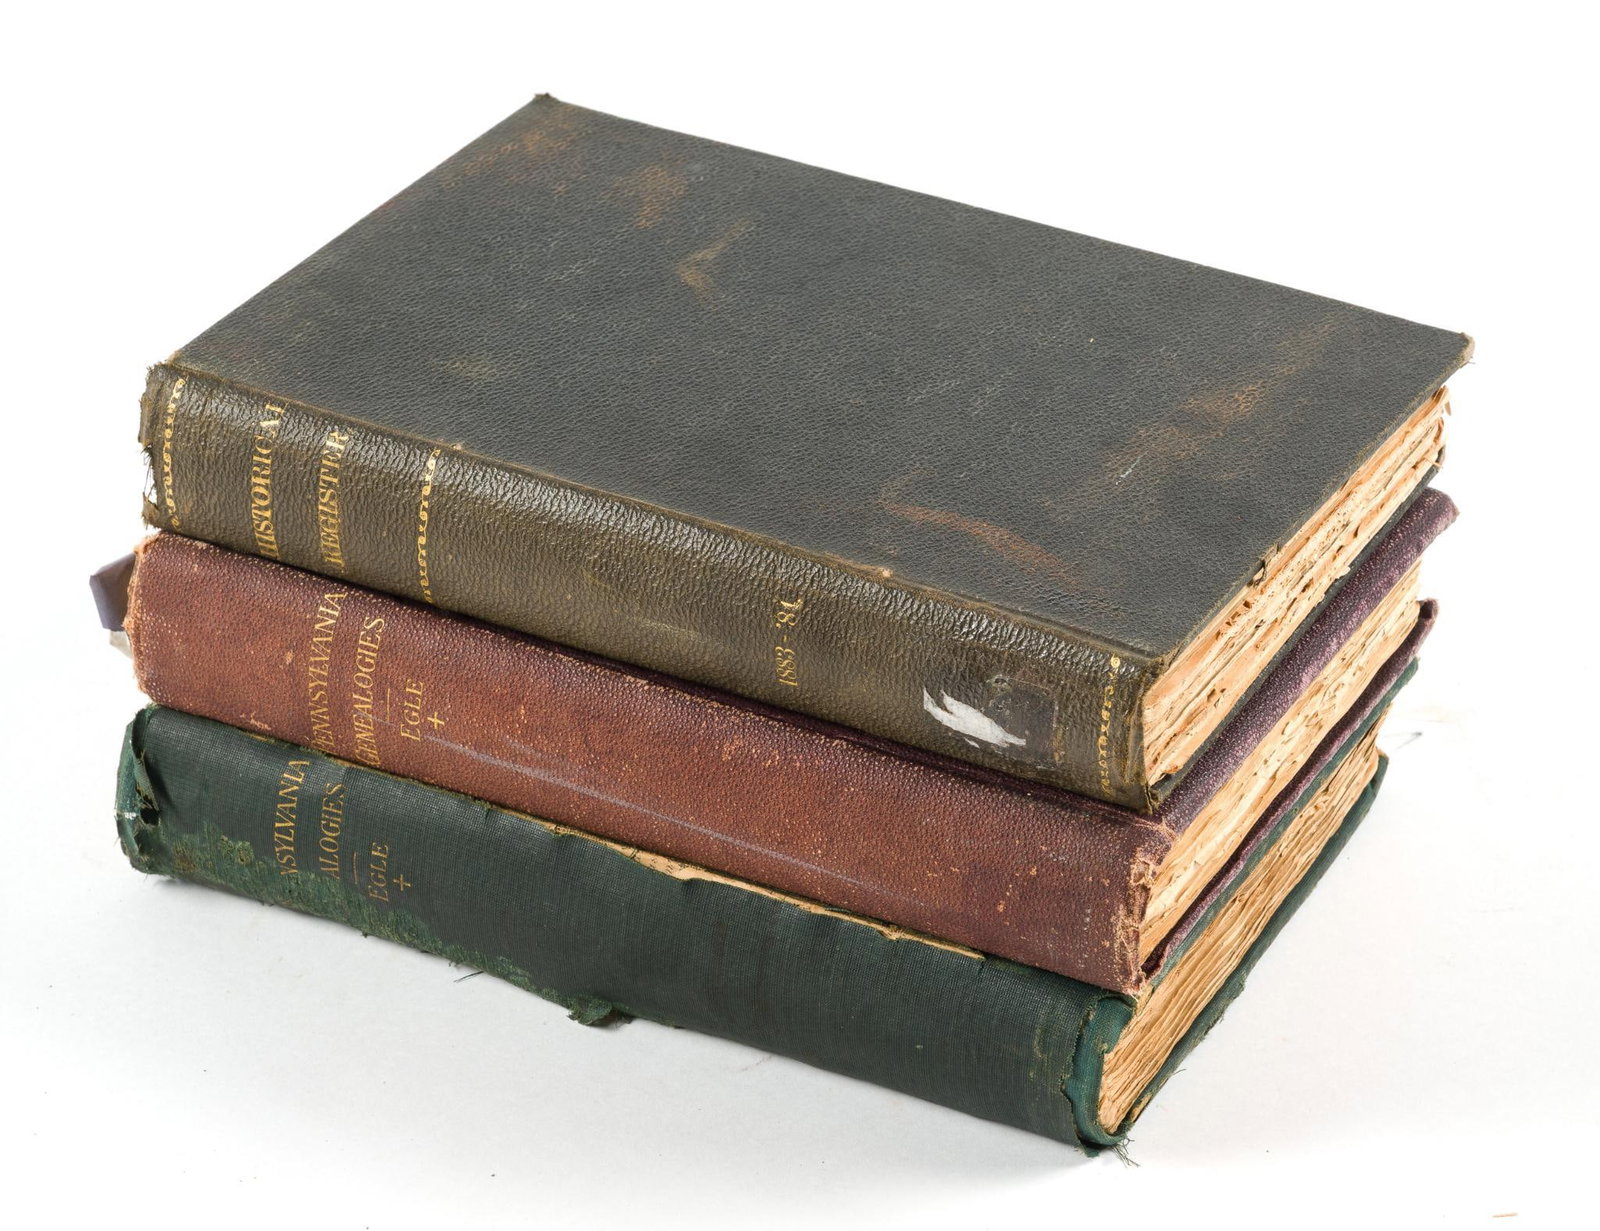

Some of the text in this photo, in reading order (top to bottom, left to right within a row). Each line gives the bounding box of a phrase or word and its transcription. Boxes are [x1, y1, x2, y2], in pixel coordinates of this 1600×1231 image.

[251, 401, 287, 557] HISTORICAL
[318, 430, 350, 568] REGISTER
[309, 591, 349, 756] PENNSYLVANIA
[352, 616, 385, 766] GENEALOGIES
[401, 678, 425, 742] EGLE
[368, 842, 389, 902] EGLE
